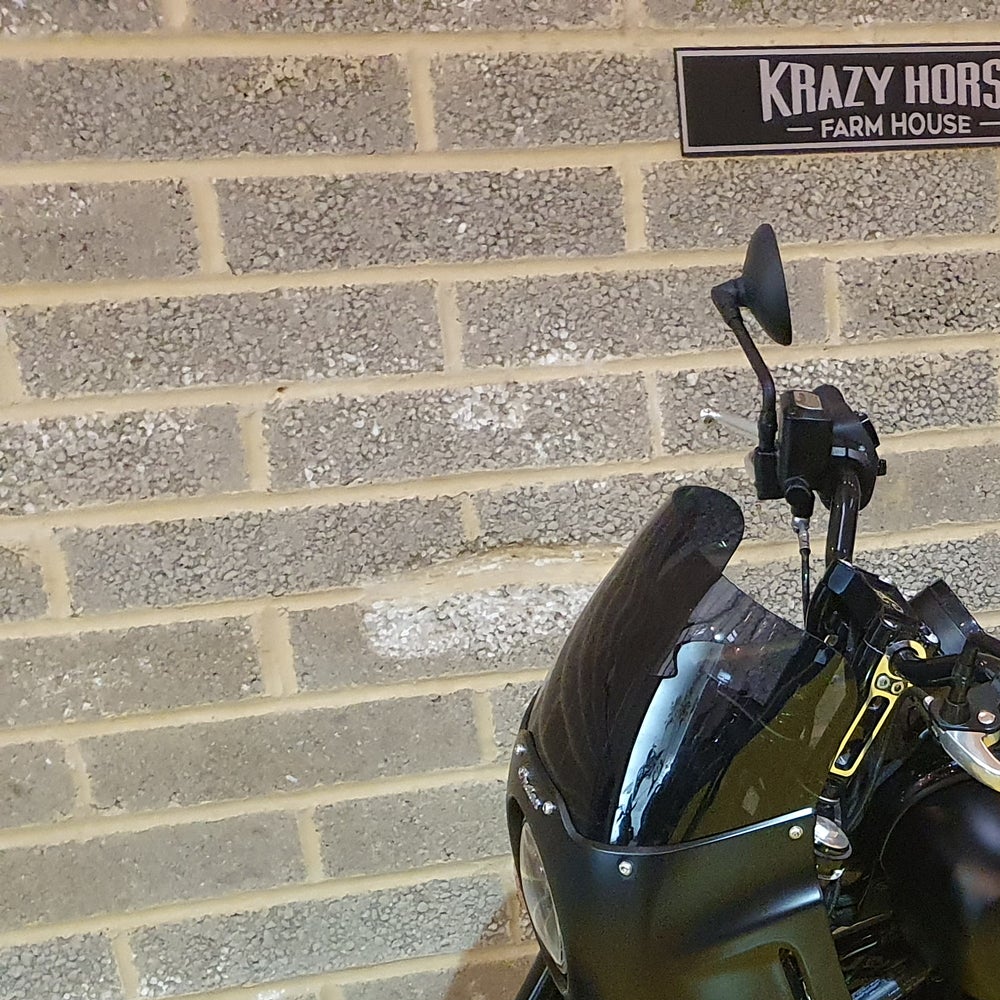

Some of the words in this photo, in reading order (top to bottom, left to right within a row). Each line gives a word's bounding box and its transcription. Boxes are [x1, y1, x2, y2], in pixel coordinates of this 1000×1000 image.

[758, 58, 895, 122] KRAZY
[820, 114, 884, 138] FARM
[890, 112, 972, 136] HOUSE
